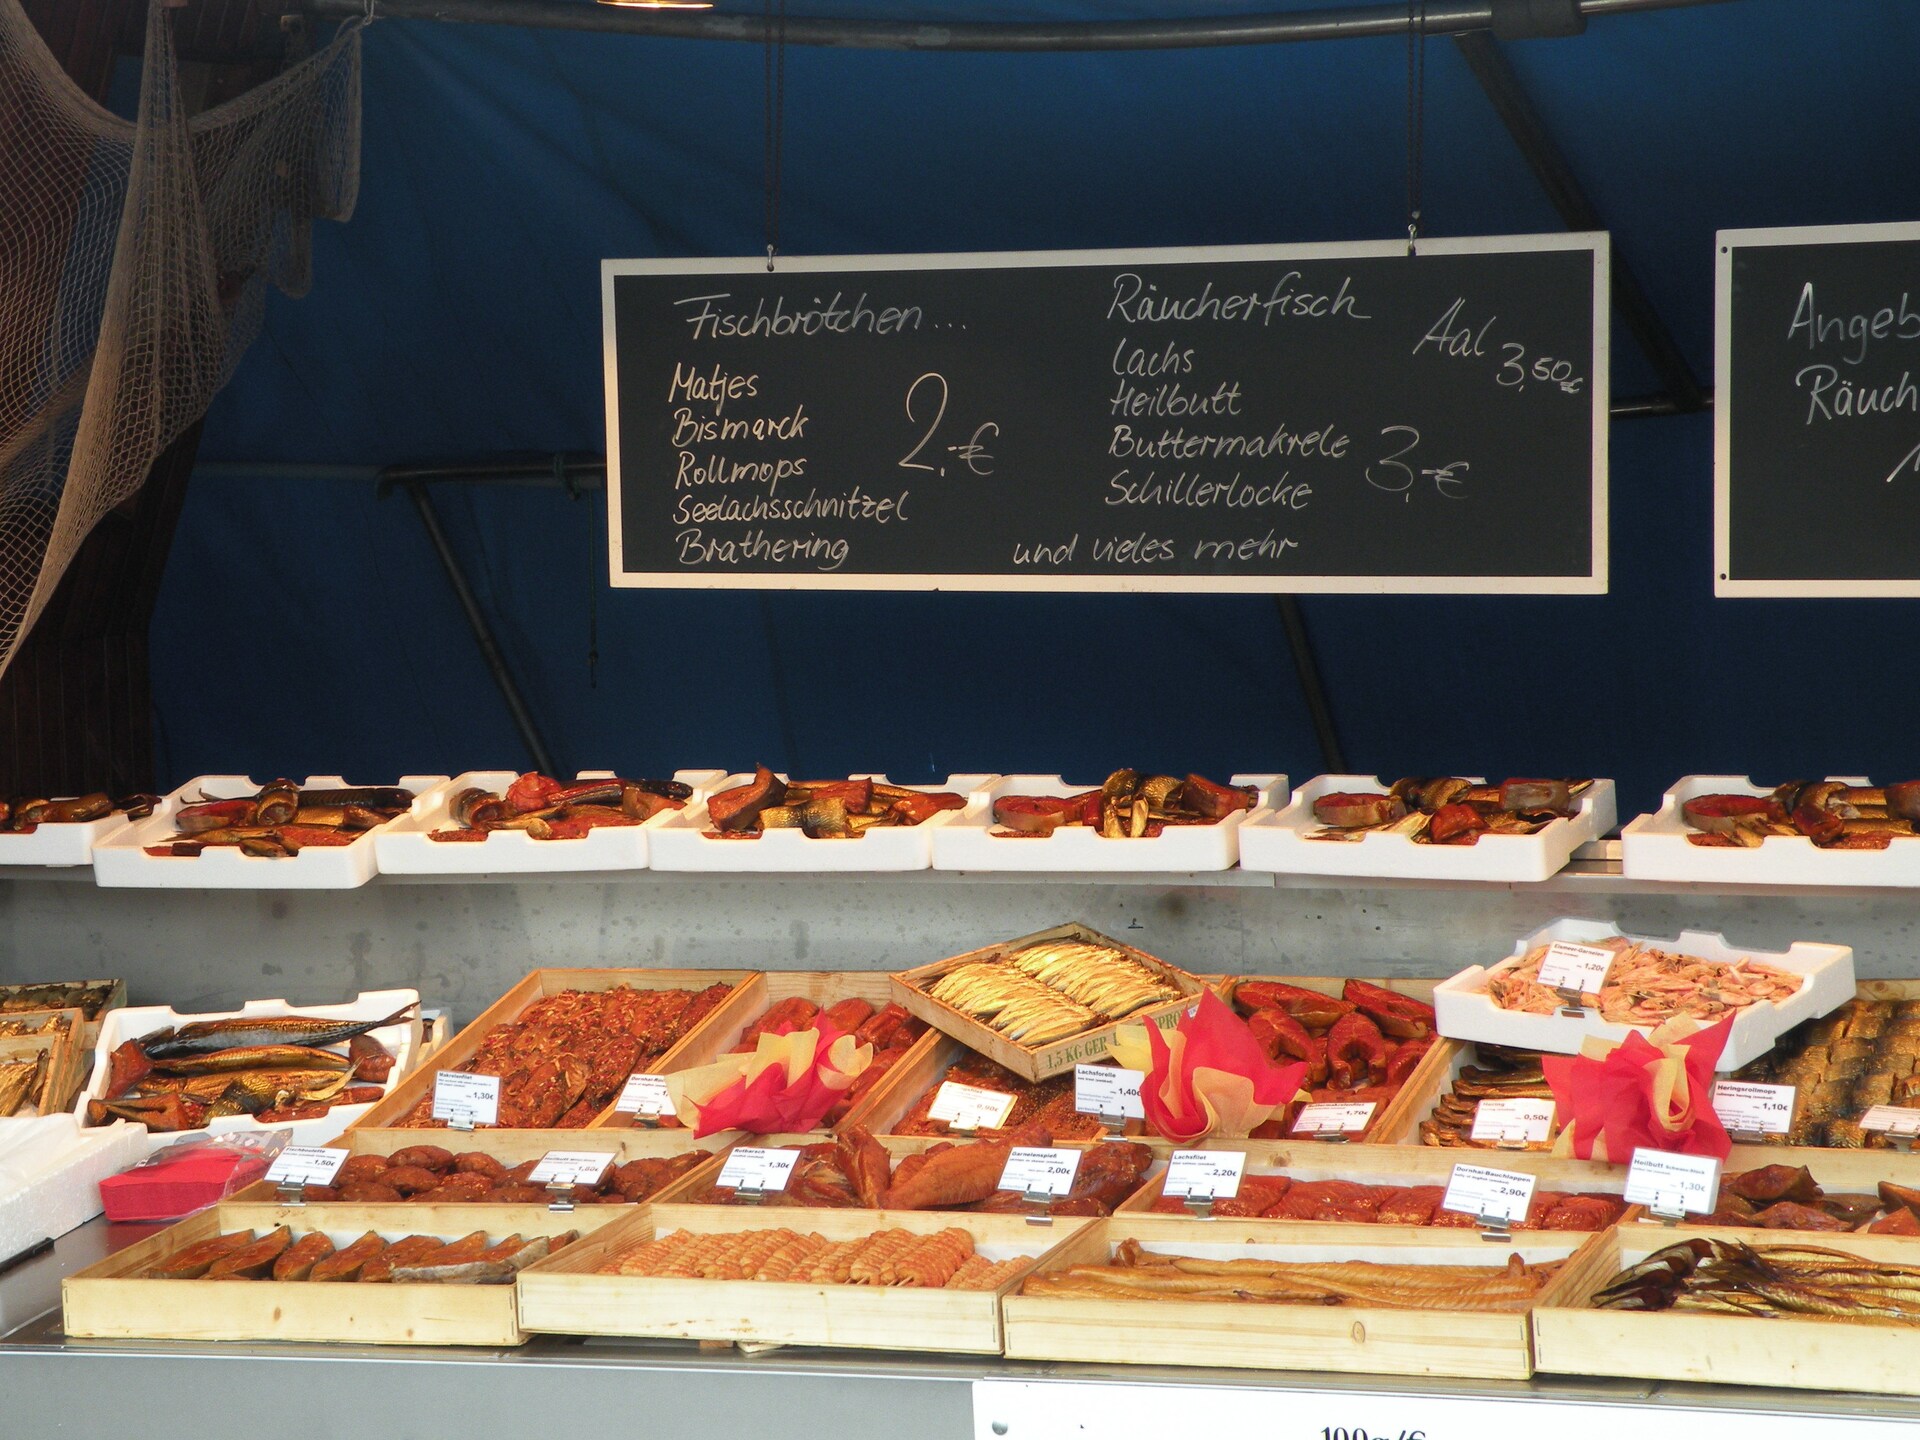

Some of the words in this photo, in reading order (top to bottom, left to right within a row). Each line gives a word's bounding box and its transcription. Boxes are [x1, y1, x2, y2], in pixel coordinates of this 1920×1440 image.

[674, 292, 921, 339] Fischbrötchen
[1107, 271, 1372, 326] Räucherfisch
[1412, 297, 1497, 356] Aal
[1112, 337, 1195, 376] Lachs
[1496, 342, 1584, 394] 3,50€
[668, 362, 759, 416] Matjes
[1110, 380, 1242, 417] Heilbutt
[1795, 363, 1918, 425] Räuch
[672, 404, 809, 447] Bismarck
[1108, 423, 1350, 459] Buttermakrele
[675, 456, 807, 496] Rollmops
[1105, 470, 1313, 510] Schillerlocke
[673, 485, 909, 525] Seelachsschnitzel
[675, 528, 850, 571] Brathering
[1013, 533, 1079, 565] und
[1194, 529, 1299, 560] mehr
[1585, 963, 1605, 972] 1,20€
[1066, 1043, 1083, 1065] KG
[473, 1091, 494, 1100] 1,30€
[1717, 1084, 1777, 1095] Heringsrollmops
[1762, 1102, 1789, 1111] 1,10€
[1523, 1113, 1549, 1121] 0,50€
[314, 1159, 336, 1167] 1,50€
[768, 1161, 790, 1169] 1,30€
[1047, 1166, 1071, 1175] 2,00€
[1212, 1169, 1238, 1177] 2,20€
[1499, 1186, 1527, 1198] 2,90€
[1680, 1181, 1707, 1192] 1,30€
